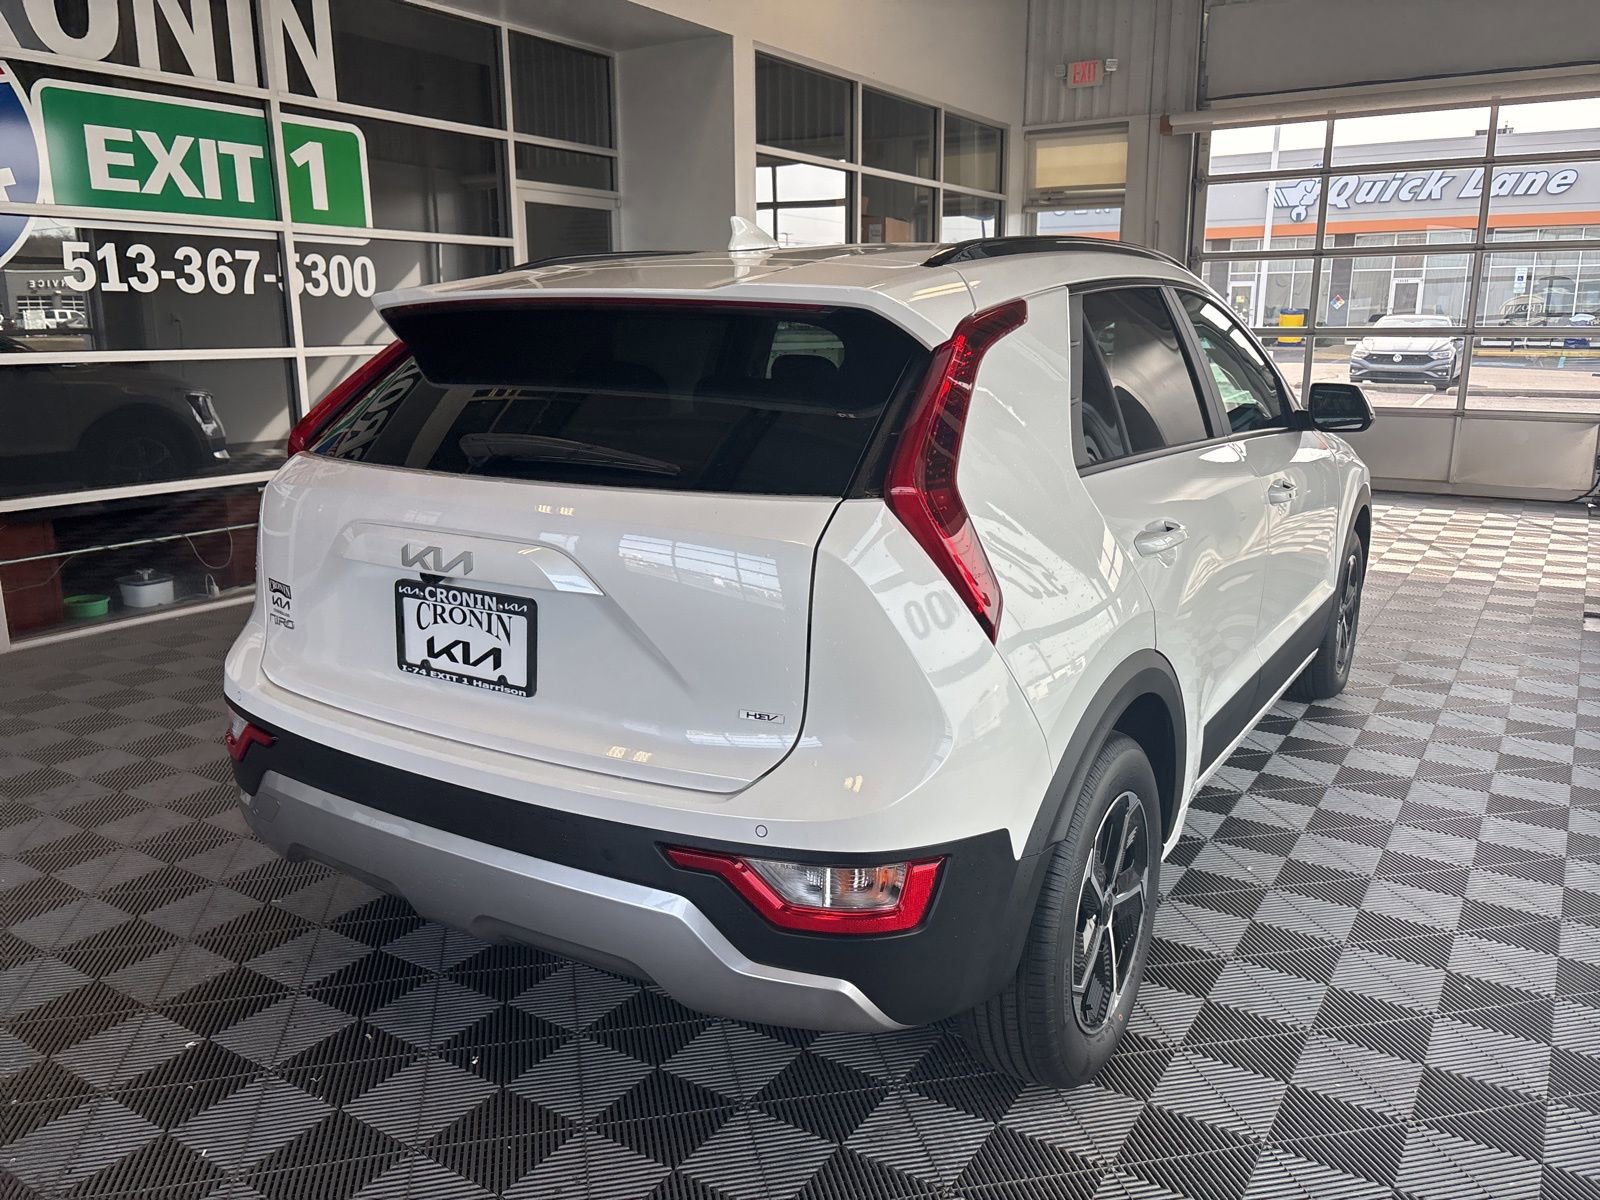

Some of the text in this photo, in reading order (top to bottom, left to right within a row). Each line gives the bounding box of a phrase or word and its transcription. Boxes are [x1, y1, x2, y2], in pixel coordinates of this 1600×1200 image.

[0, 0, 338, 101] ONIN
[1072, 61, 1098, 84] EXIT
[83, 124, 264, 203] EXIT
[289, 141, 329, 211] 1
[1328, 168, 1578, 208] Quick Lane
[401, 543, 473, 575] KIA
[272, 595, 290, 610] KIA
[398, 586, 528, 612] KIA CRONIN KIA
[416, 601, 512, 646] CRONIN
[426, 635, 502, 671] KIA
[402, 664, 527, 697] I-74 EXIT 1 Harrison
[746, 711, 778, 721] HEV
